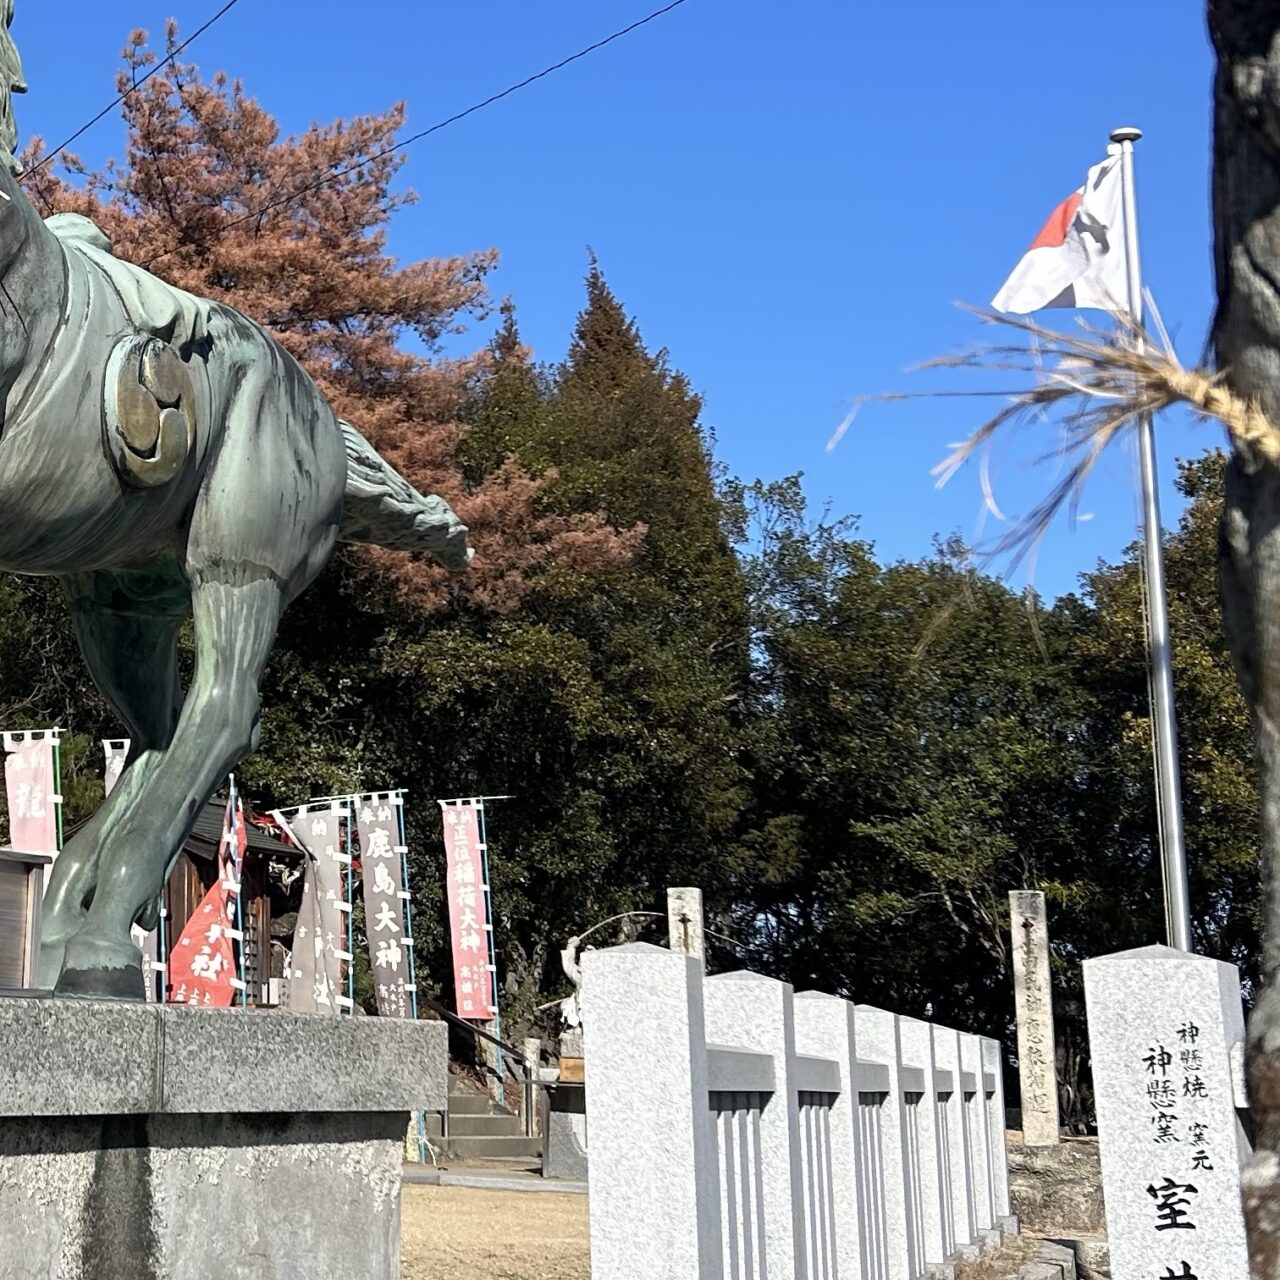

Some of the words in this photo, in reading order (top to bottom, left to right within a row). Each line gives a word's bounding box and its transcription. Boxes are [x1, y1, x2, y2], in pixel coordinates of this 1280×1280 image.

[360, 806, 392, 824] 奉納
[366, 827, 402, 971] 鹿島大神
[1142, 1045, 1180, 1144] 神懸窯
[1188, 1122, 1214, 1171] 窯元
